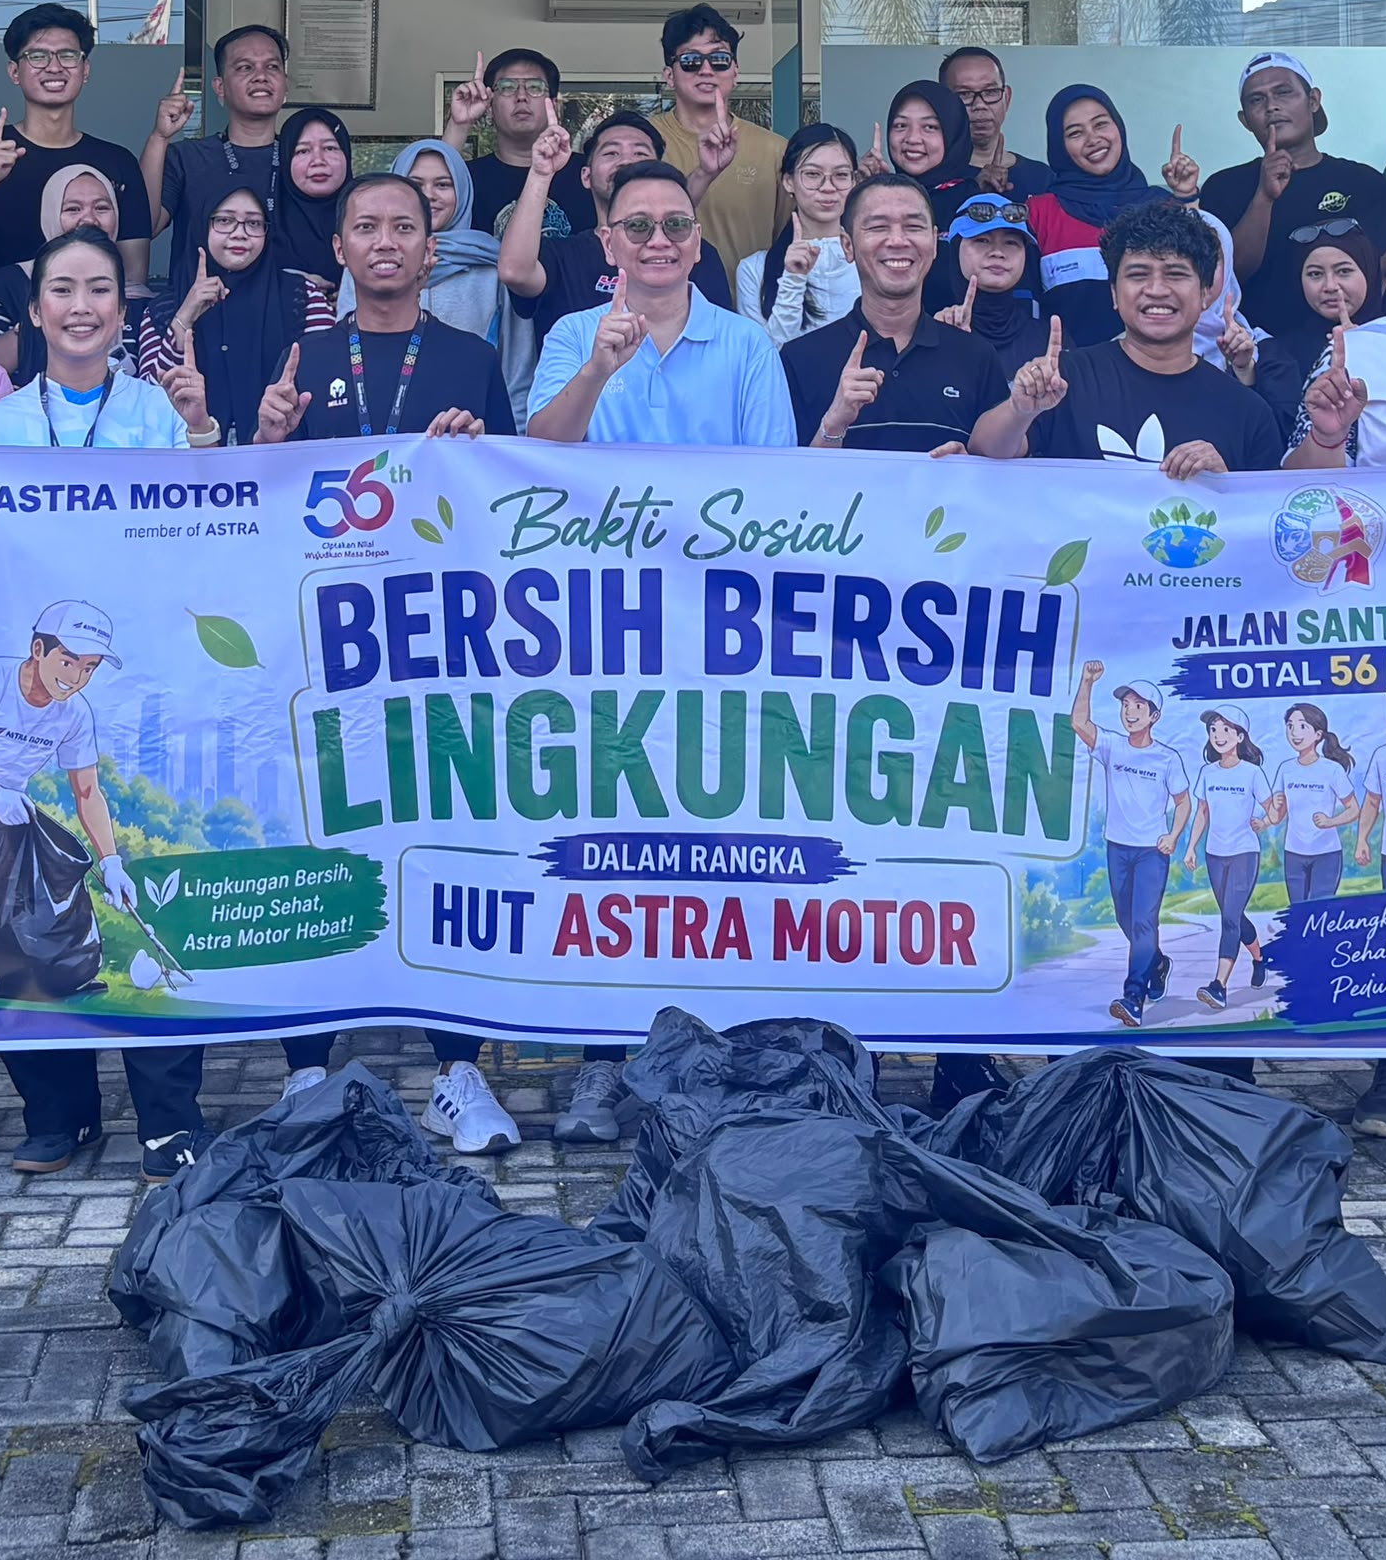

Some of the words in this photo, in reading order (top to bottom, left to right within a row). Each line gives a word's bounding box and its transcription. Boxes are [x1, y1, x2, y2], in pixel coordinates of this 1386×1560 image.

[129, 481, 259, 510] MOTOR
[124, 524, 183, 539] member
[186, 523, 201, 537] of
[205, 522, 260, 536] ASTRA
[490, 484, 677, 561] Bakti
[683, 488, 865, 561] Sosial
[1123, 573, 1155, 588] AM
[1159, 573, 1242, 590] Greeners
[315, 567, 664, 693] BERSIH
[704, 569, 1063, 698] BERSIH
[1172, 610, 1288, 651] JALAN
[1209, 661, 1322, 690] TOTAL
[1330, 654, 1377, 685] 56
[312, 689, 1076, 843] LINGKUNGAN
[581, 843, 683, 874] DALAM
[689, 845, 807, 876] RANGKA
[184, 874, 289, 900] Lingkungan
[295, 863, 354, 888] Bersih,
[211, 902, 264, 923] Hidup
[269, 894, 325, 918] Sehat,
[431, 882, 535, 955] HUT
[553, 892, 754, 961] ASTRA
[772, 897, 978, 967] MOTOR
[183, 932, 231, 952] Astra
[237, 927, 291, 947] Motor
[296, 914, 355, 942] Hebat!
